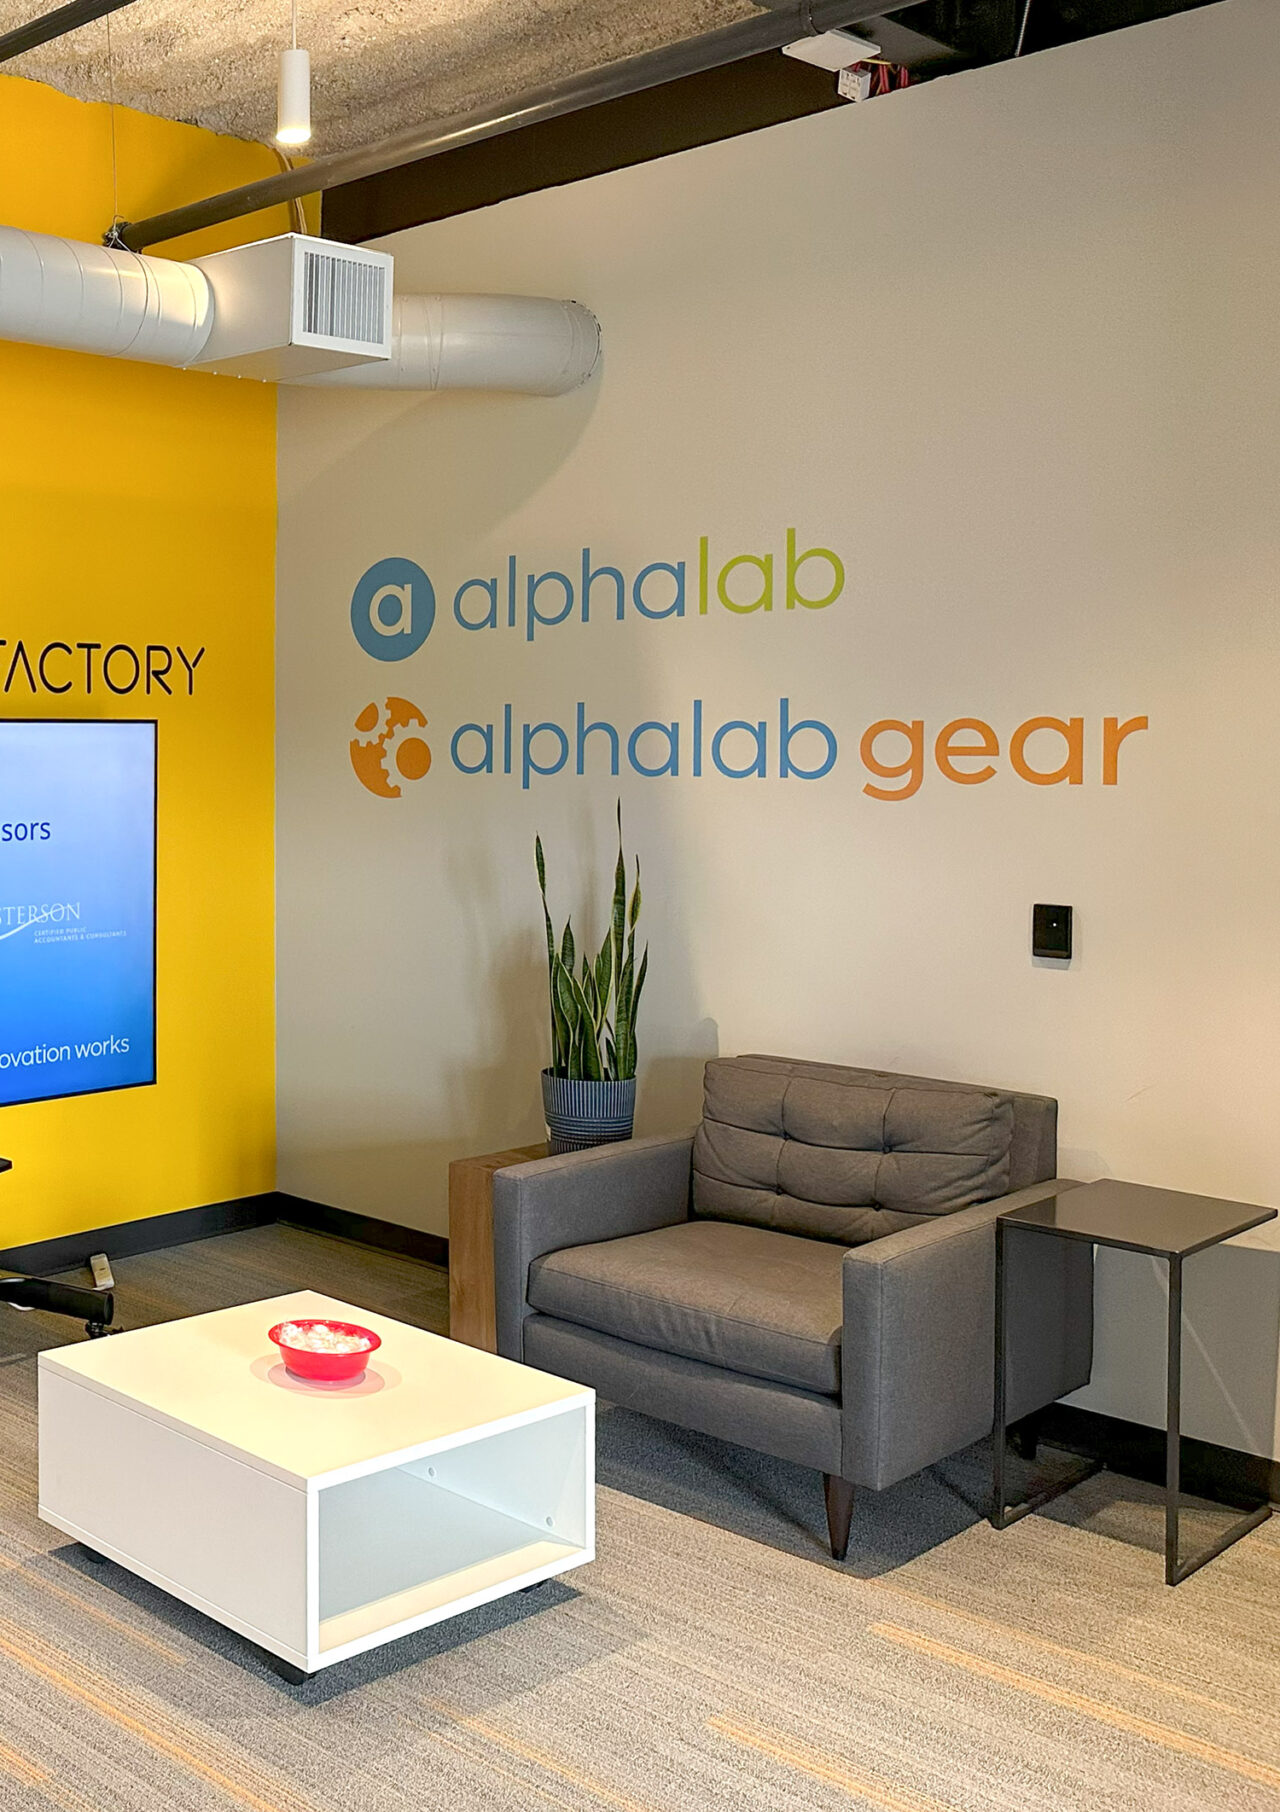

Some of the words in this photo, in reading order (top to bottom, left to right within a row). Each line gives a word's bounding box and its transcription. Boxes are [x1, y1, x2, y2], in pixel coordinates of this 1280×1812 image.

[454, 528, 844, 642] alphalab
[451, 696, 839, 790] alphalab
[860, 716, 1148, 801] gear
[34, 934, 78, 944] ACCOUNTANTS
[75, 1035, 129, 1058] works
